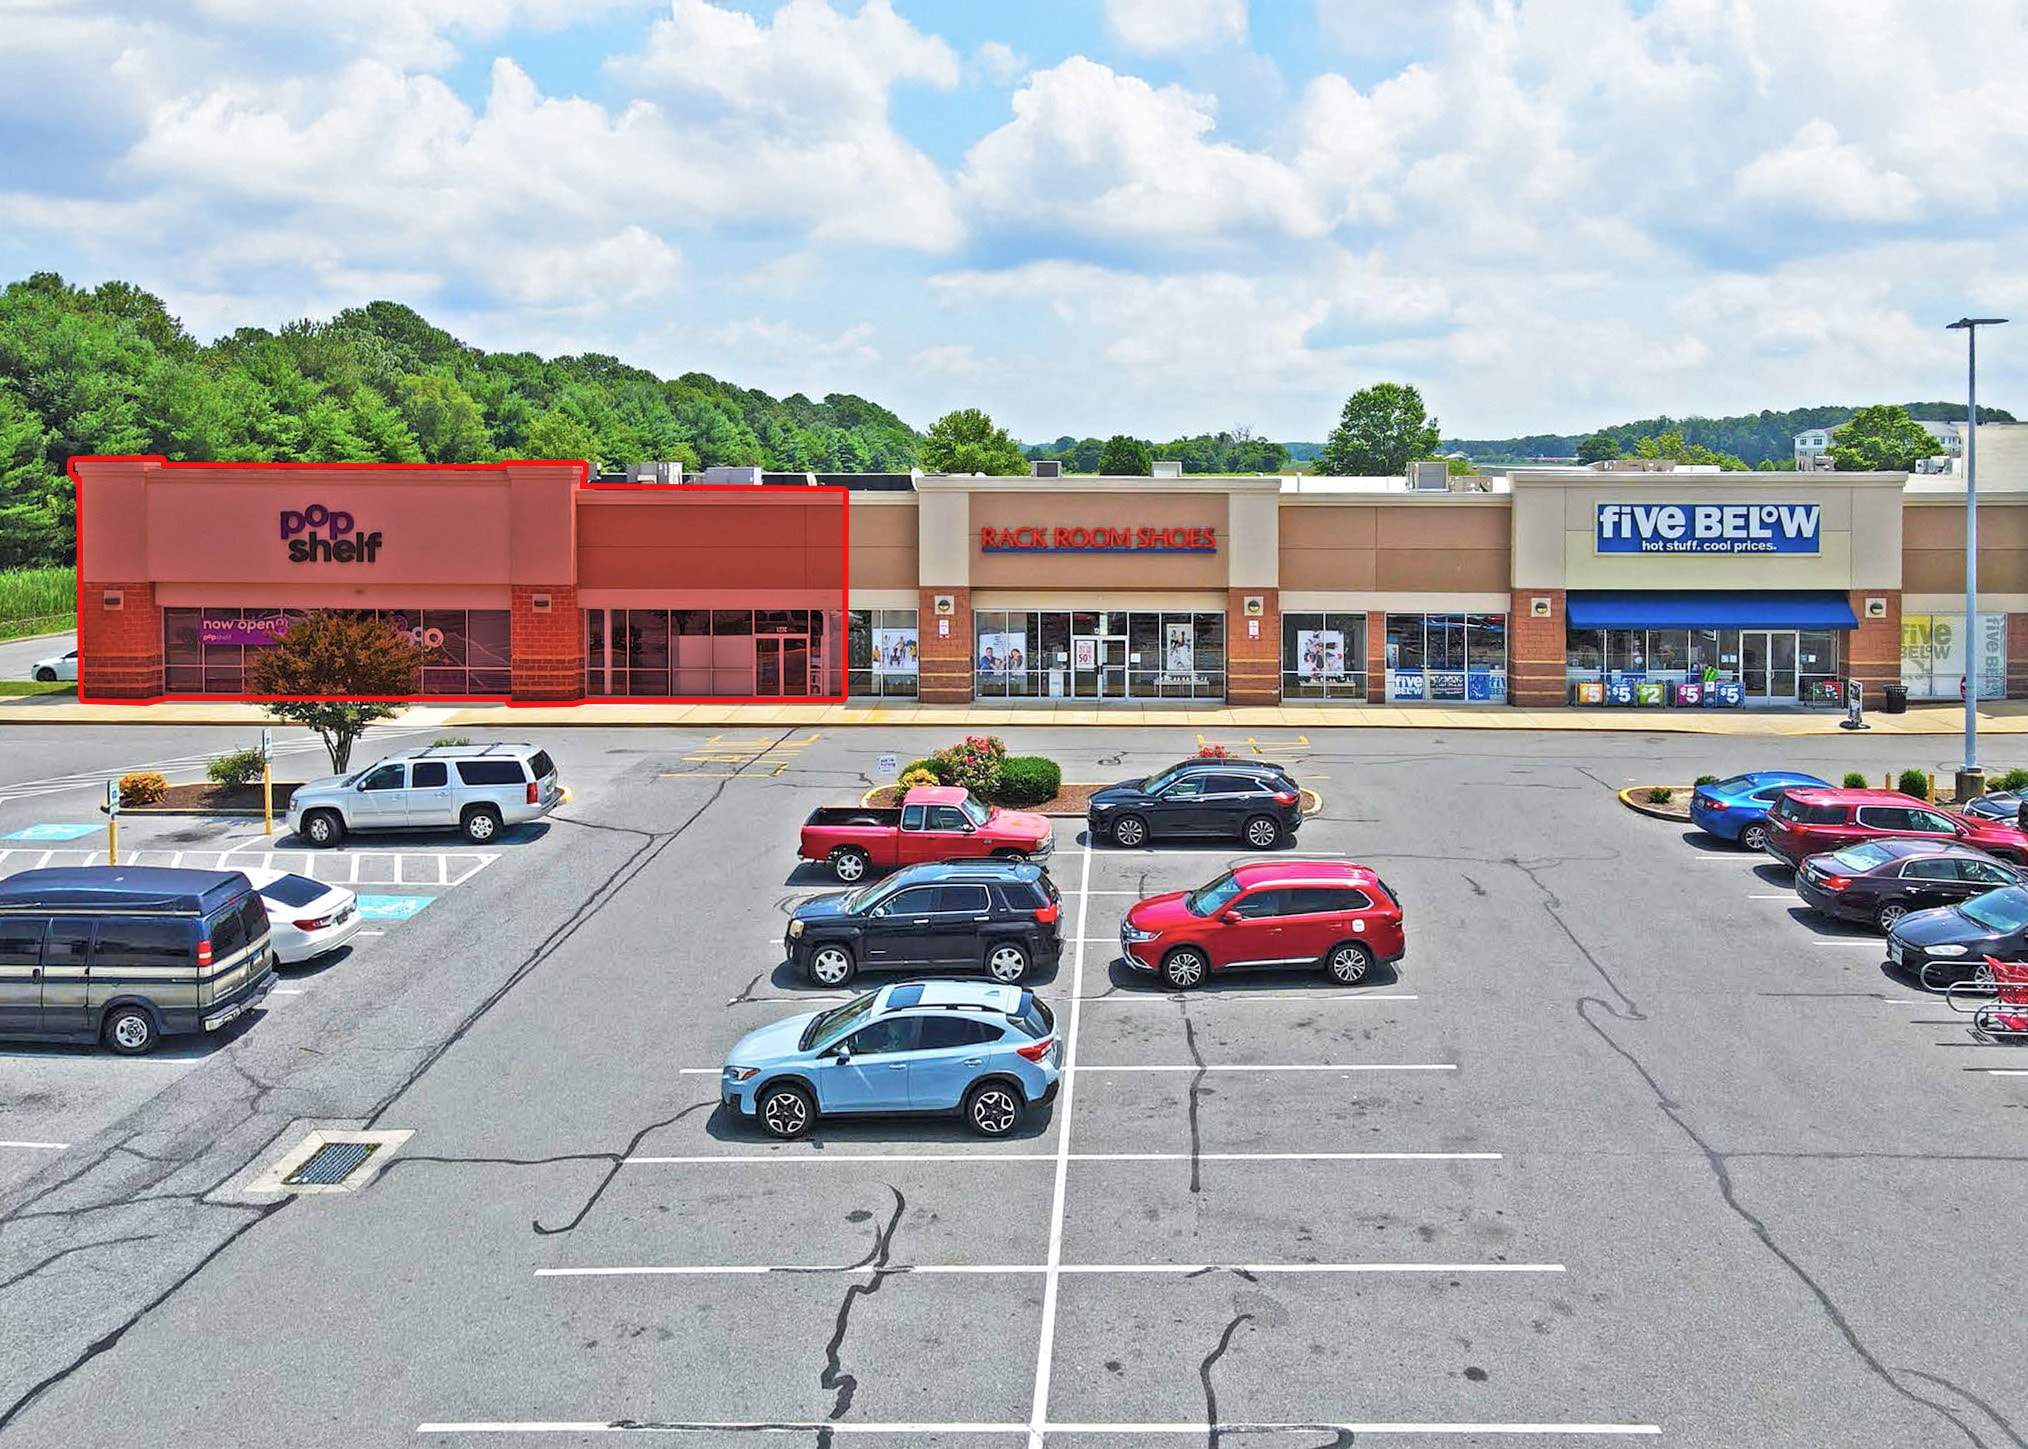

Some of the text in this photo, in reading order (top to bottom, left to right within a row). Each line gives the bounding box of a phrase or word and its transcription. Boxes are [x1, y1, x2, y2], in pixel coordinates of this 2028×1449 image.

[280, 504, 355, 540] pop
[981, 527, 1217, 548] RACK ROOM SHOES
[288, 531, 382, 562] shelf
[1642, 540, 1777, 553] hot stuff. cool prices.
[203, 620, 275, 634] now open
[1395, 676, 1423, 688] five
[1583, 686, 1601, 702] $5
[1612, 686, 1631, 703] $5
[1641, 687, 1660, 703] $2
[1680, 687, 1699, 703] $5
[1720, 687, 1739, 704] $5
